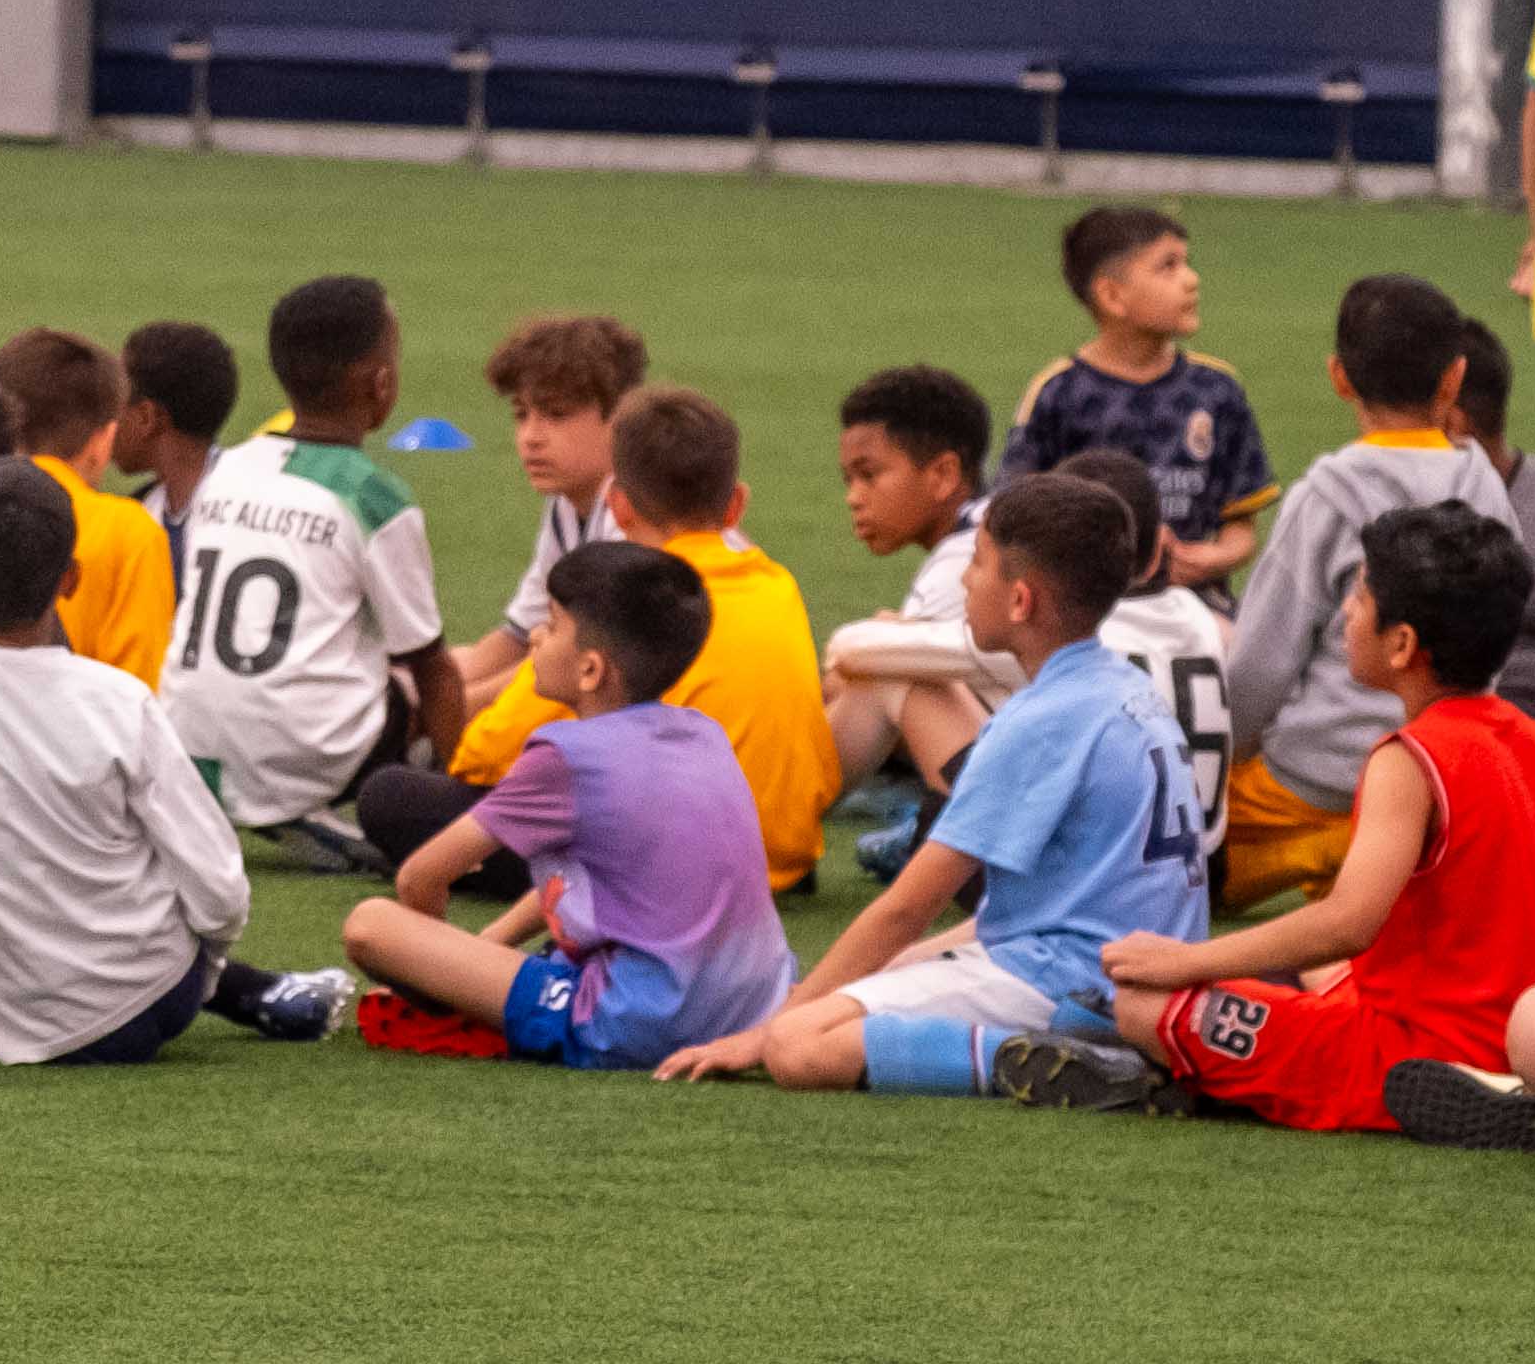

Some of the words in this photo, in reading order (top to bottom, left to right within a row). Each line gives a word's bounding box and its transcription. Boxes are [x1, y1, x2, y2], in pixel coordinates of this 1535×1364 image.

[235, 500, 339, 547] ALLISTER
[181, 547, 302, 676] 10
[1210, 995, 1266, 1058] 29
